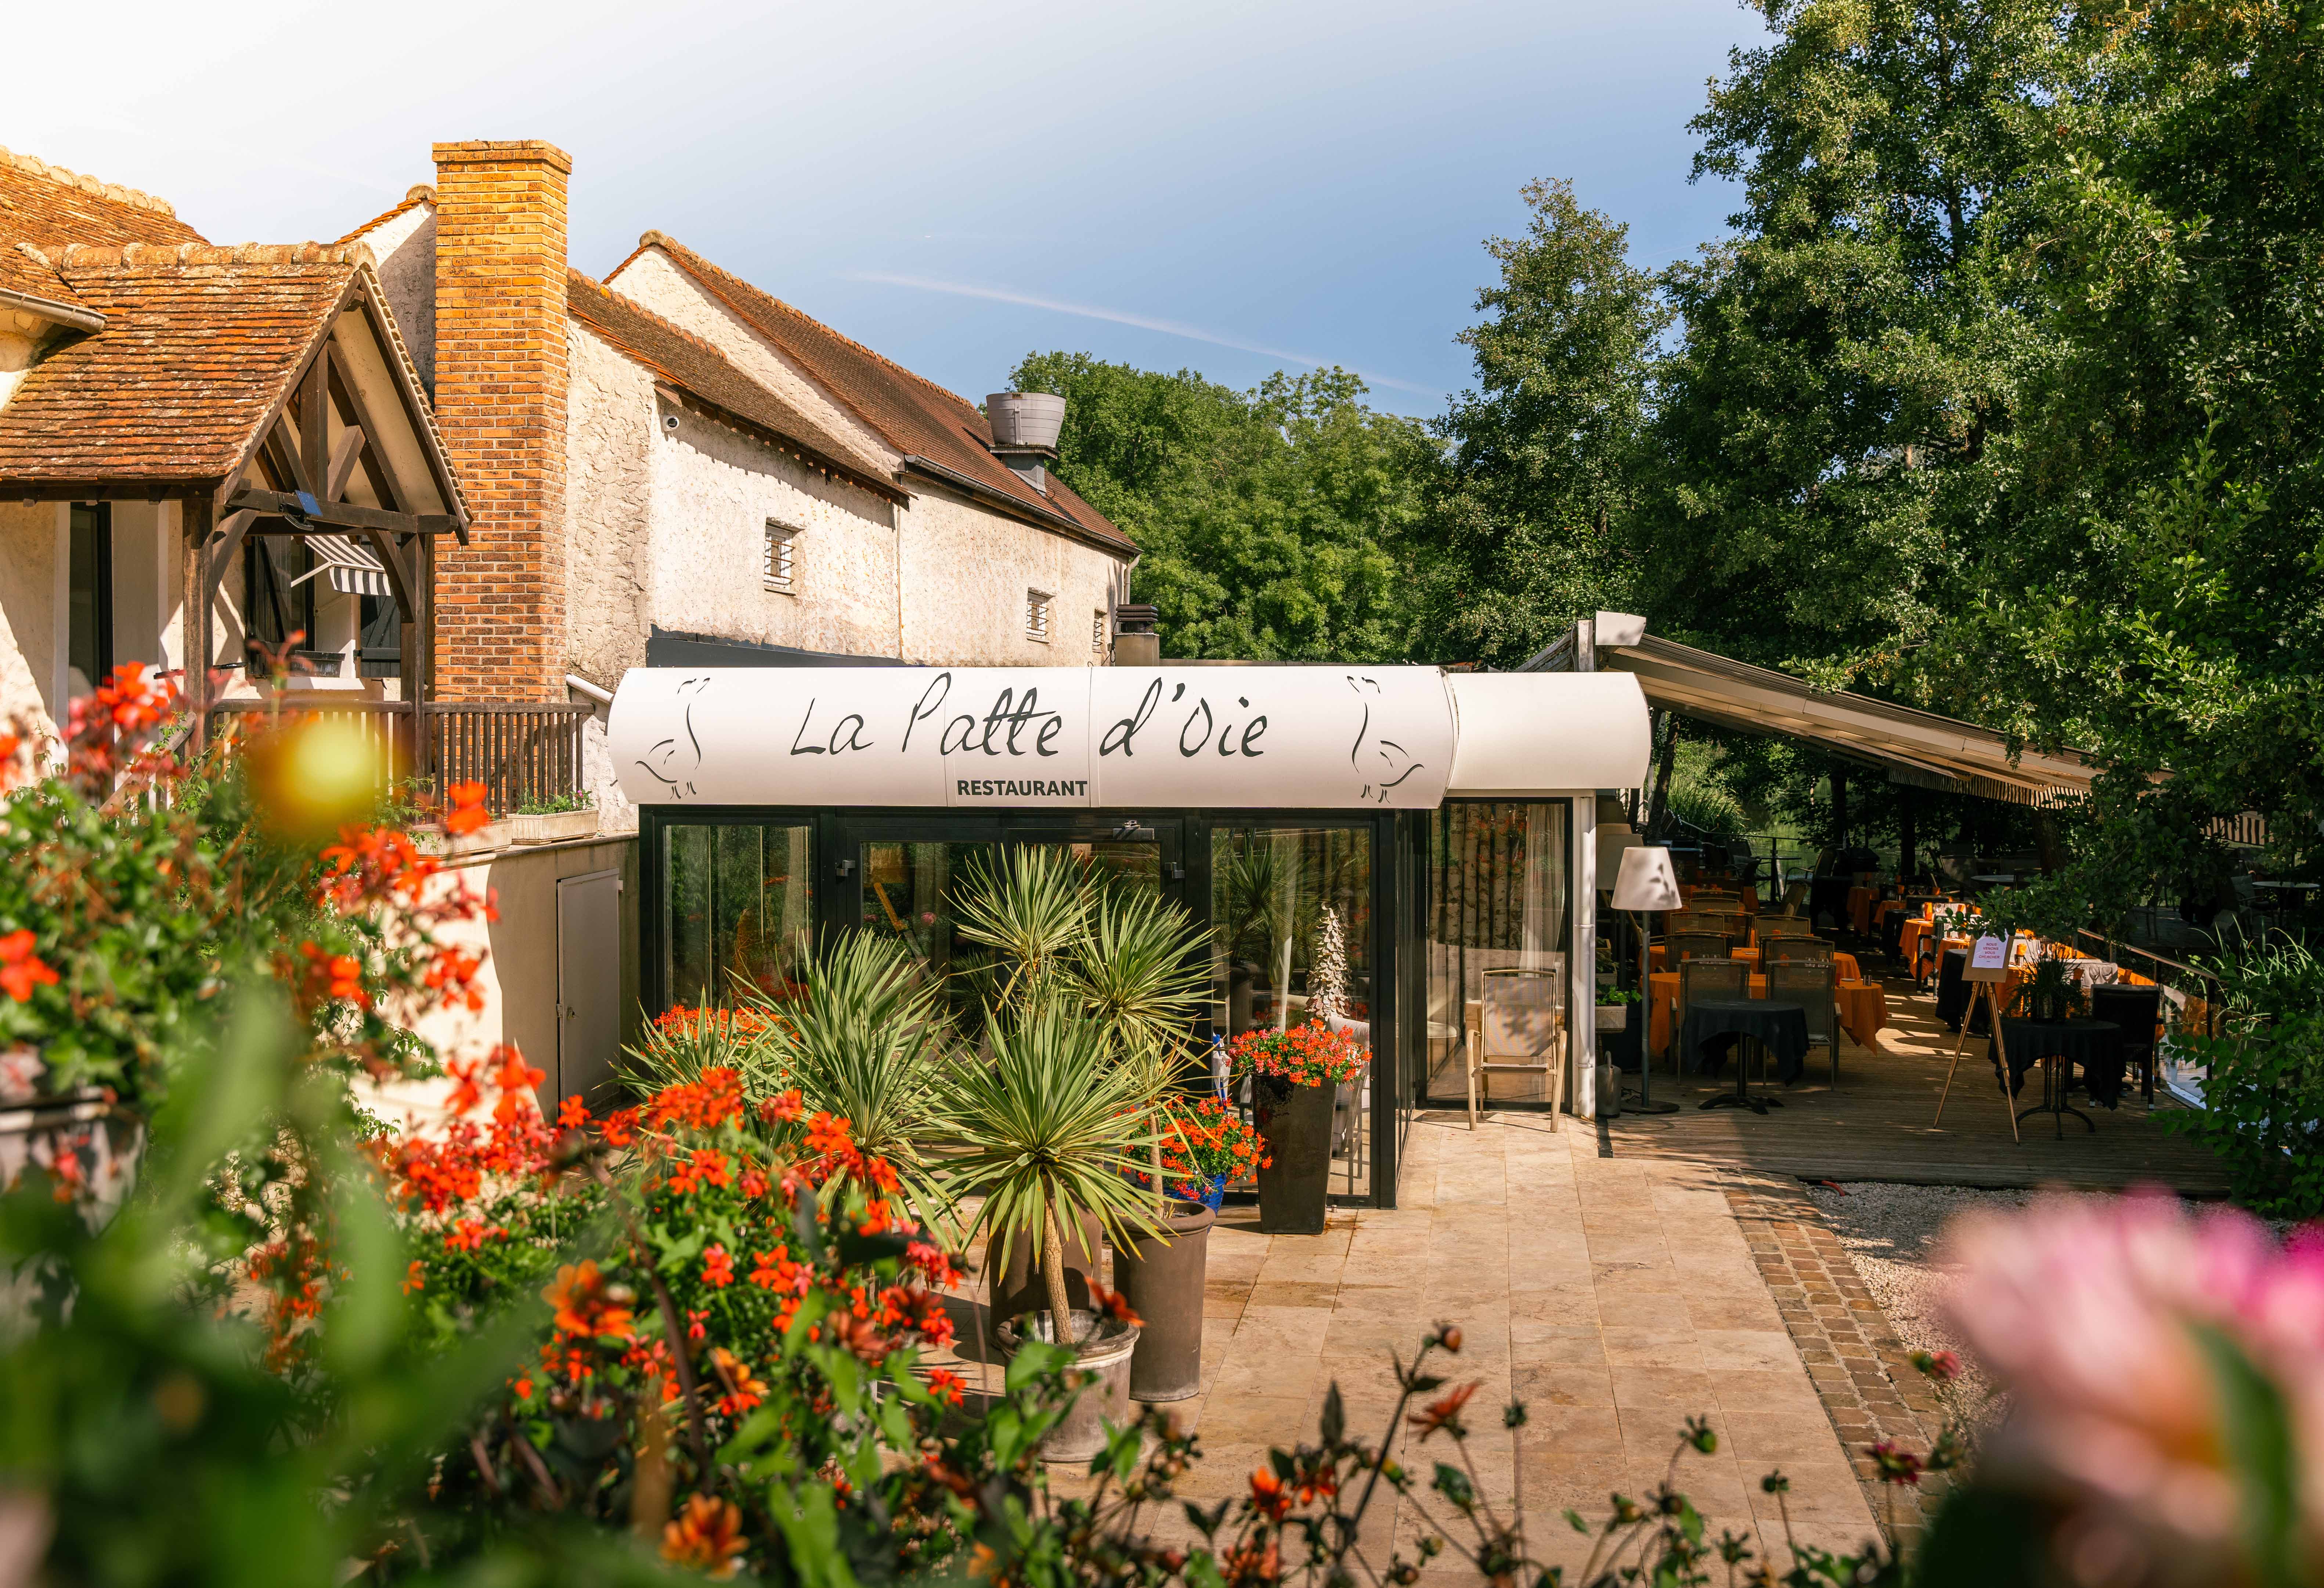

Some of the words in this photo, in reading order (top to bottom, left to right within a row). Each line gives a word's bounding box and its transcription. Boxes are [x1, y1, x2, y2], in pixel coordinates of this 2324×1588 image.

[790, 697, 874, 756] La
[902, 672, 1062, 756] Patte
[1099, 677, 1267, 758] d'Oie
[957, 779, 1088, 796] RESTAURANT
